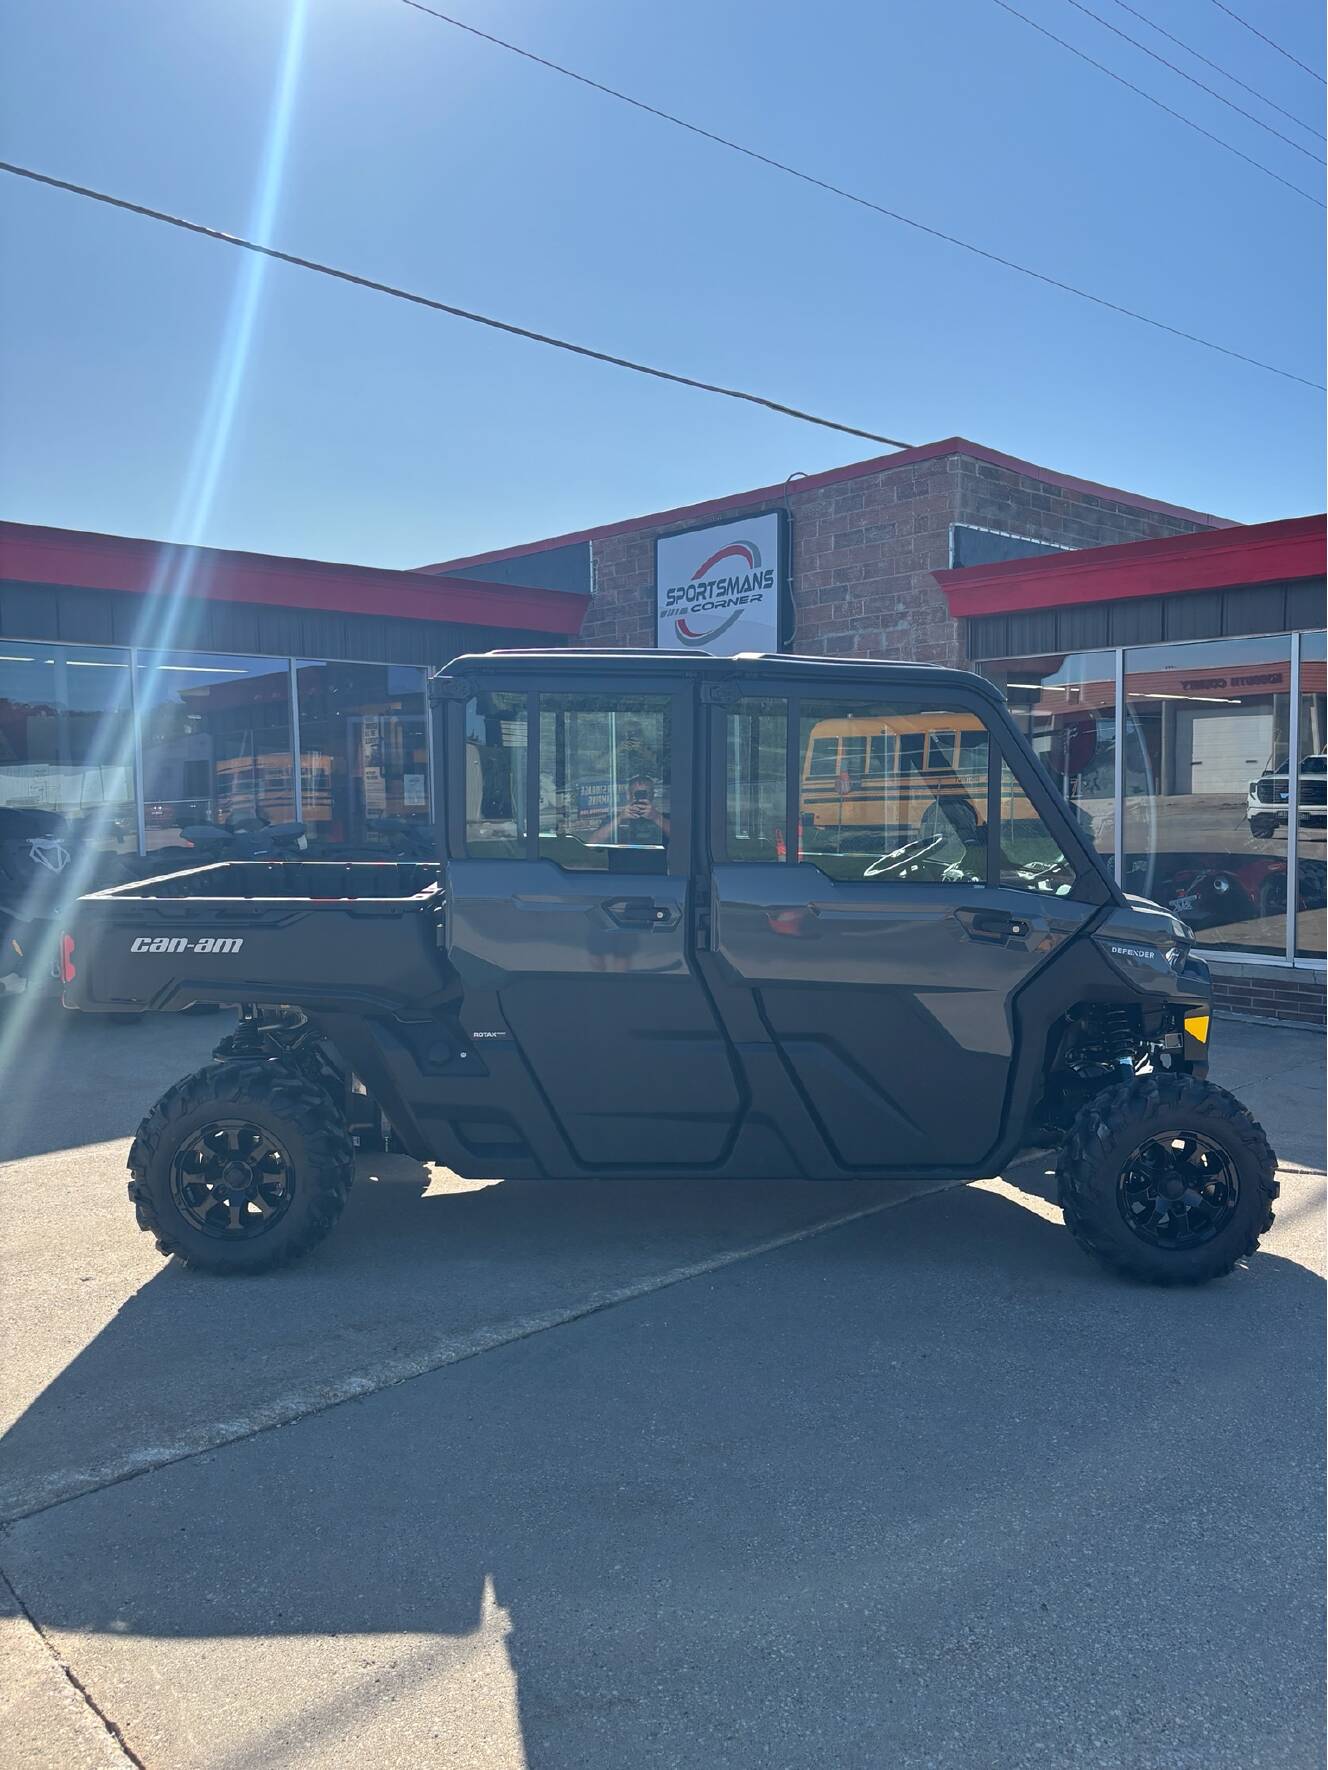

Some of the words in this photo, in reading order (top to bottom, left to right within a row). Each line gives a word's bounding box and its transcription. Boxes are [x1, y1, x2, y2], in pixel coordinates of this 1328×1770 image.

[666, 569, 774, 607] SPORTSMANS
[690, 594, 763, 613] CORNER
[130, 937, 244, 953] can-am
[1111, 946, 1155, 958] DEFENDER
